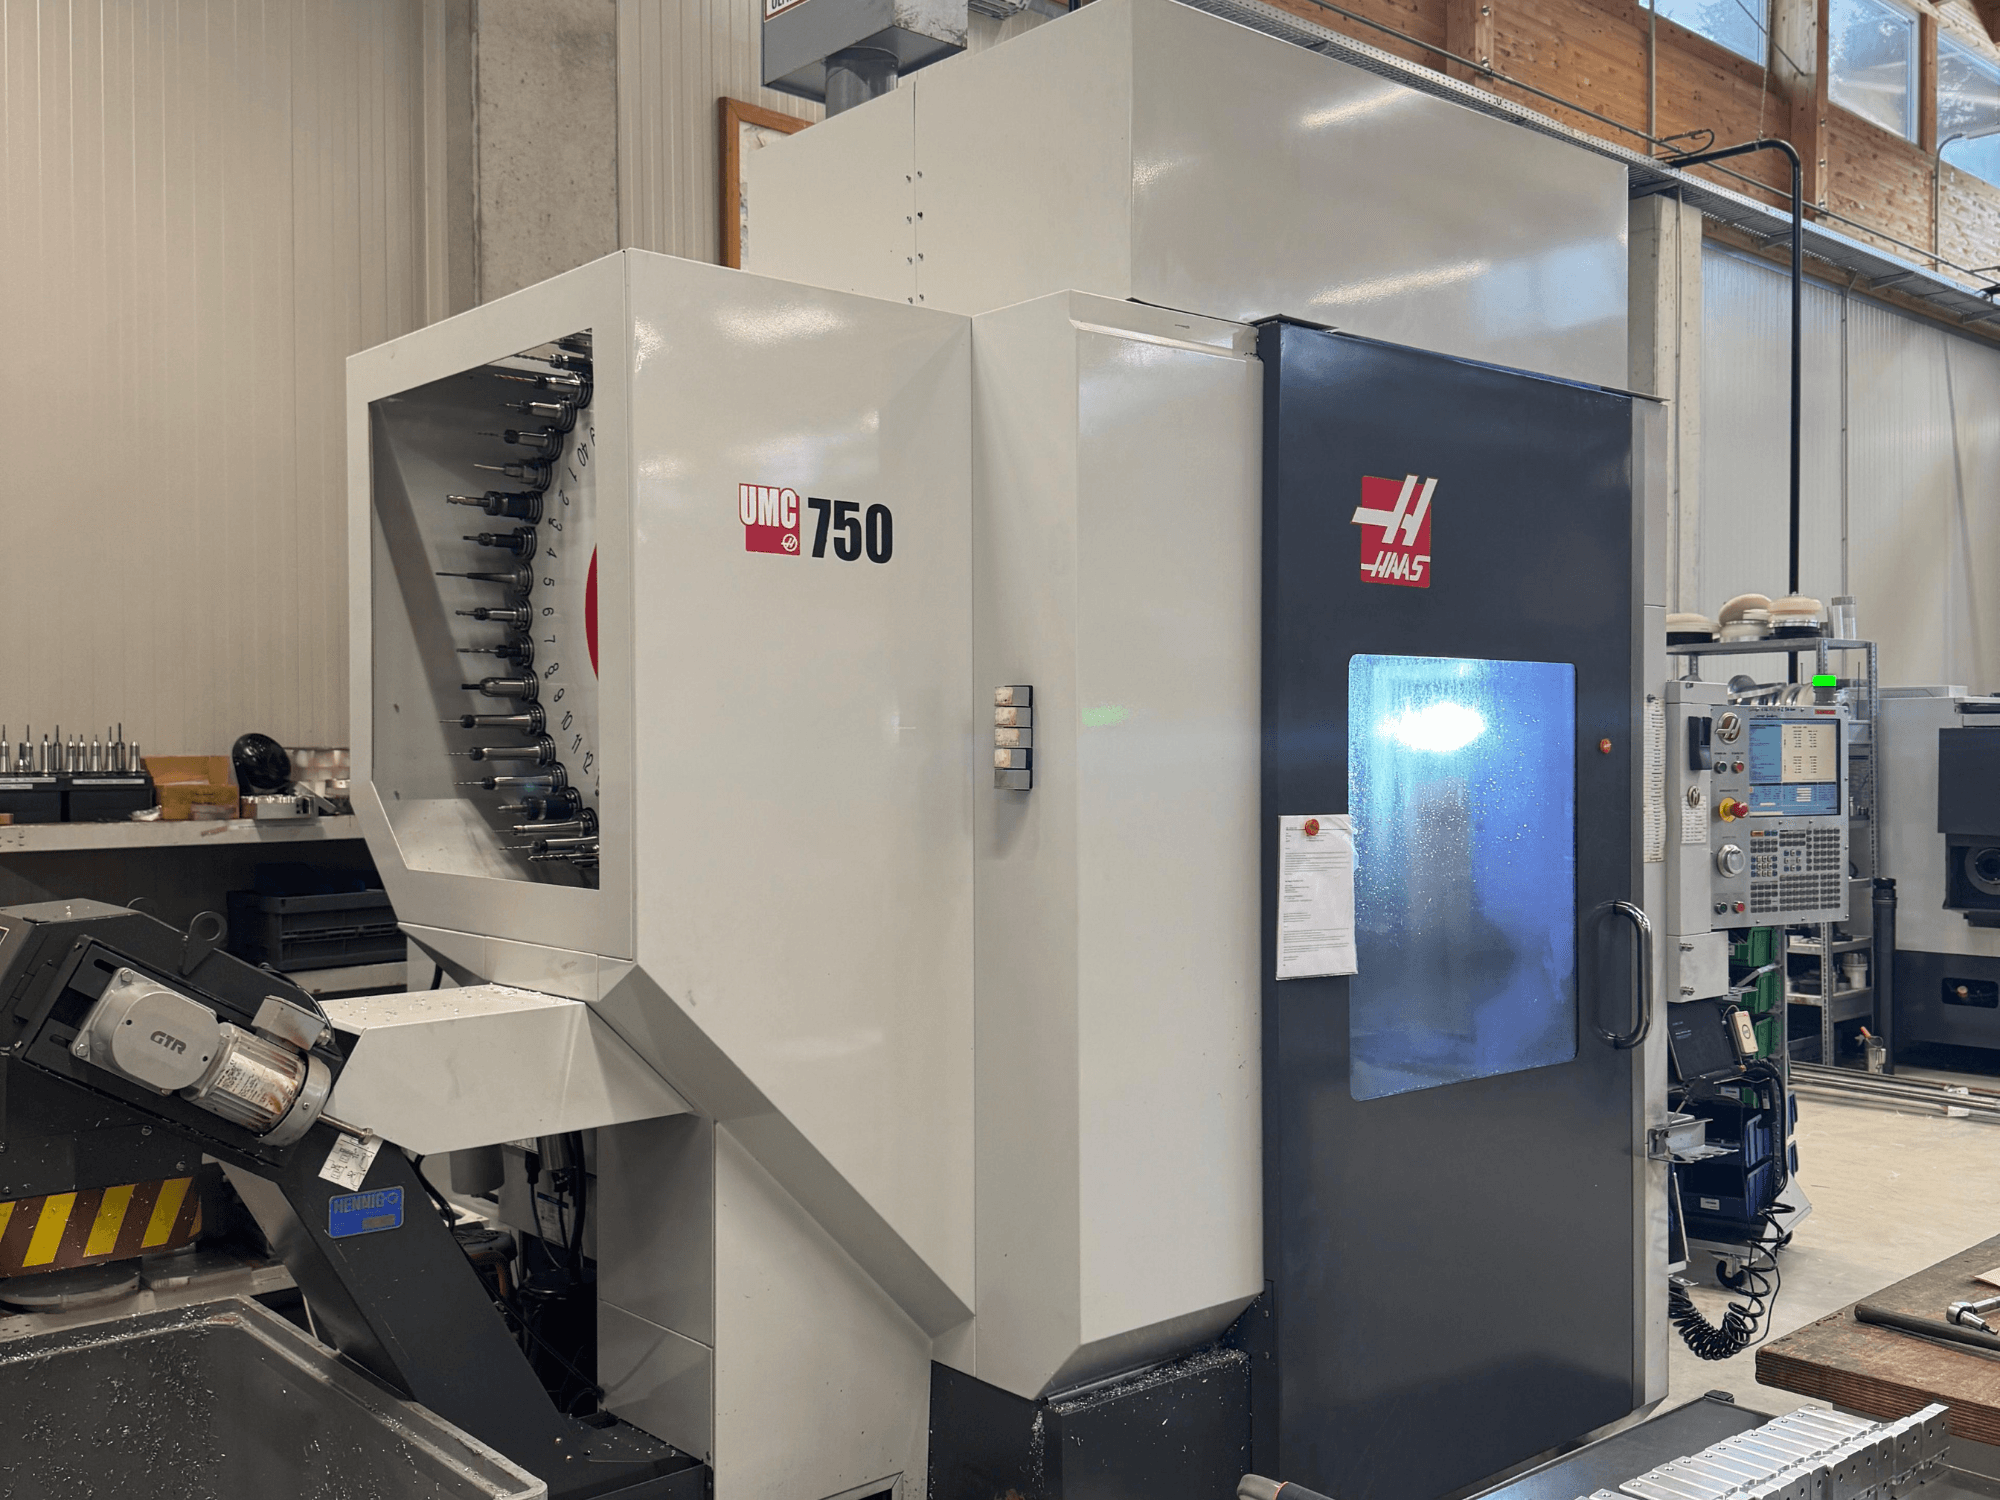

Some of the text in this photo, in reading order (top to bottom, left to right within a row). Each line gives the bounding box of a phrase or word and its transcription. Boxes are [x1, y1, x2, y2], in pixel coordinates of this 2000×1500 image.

[577, 442, 589, 467] 40
[568, 467, 578, 482] 1
[558, 489, 570, 506] 2
[551, 517, 563, 532] 3
[739, 484, 893, 564] UMC 750
[546, 547, 558, 559] 4
[1361, 550, 1431, 582] HAAS
[543, 577, 555, 587] 5
[542, 607, 554, 617] 6
[544, 634, 556, 643] 7
[548, 662, 560, 675] 8
[553, 688, 565, 702] 9
[561, 710, 573, 731] 10
[571, 733, 583, 754] 11
[582, 750, 594, 775] 12
[150, 1030, 187, 1055] GTR
[333, 1192, 386, 1214] HENNIG
